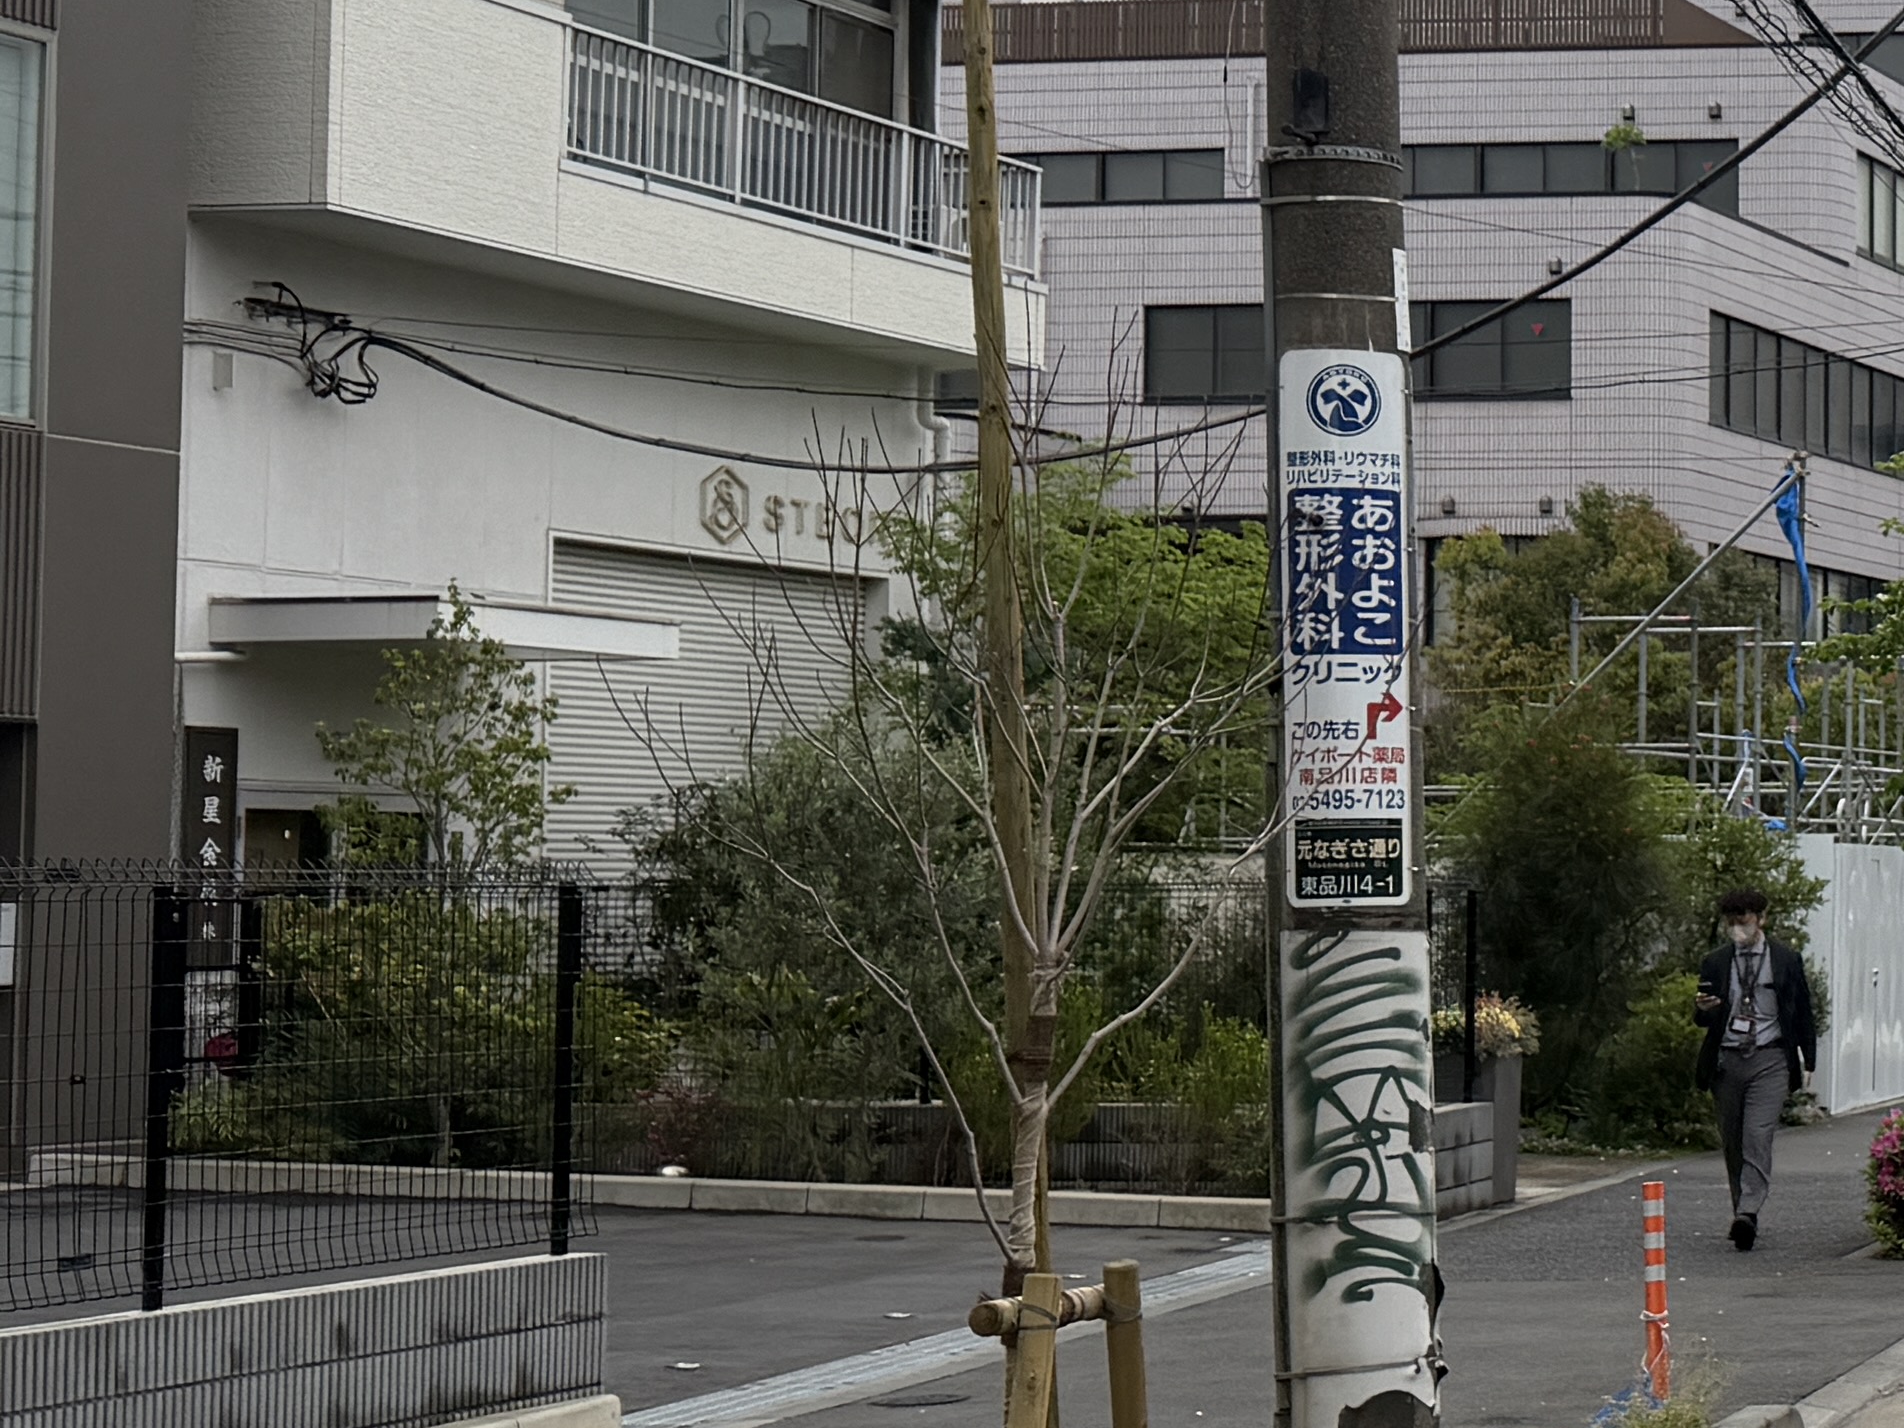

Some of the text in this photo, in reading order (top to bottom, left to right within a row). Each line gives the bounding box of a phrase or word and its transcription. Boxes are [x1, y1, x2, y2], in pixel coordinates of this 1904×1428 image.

[1286, 451, 1400, 469] 整形外科・リウマチ科
[1286, 468, 1401, 486] リハビリテーション科
[1293, 493, 1345, 651] 整形外科
[1351, 495, 1396, 645] あおよこ
[1291, 660, 1402, 686] クリニック
[1292, 720, 1360, 740] この先右
[1291, 746, 1405, 764] ケイポート薬局
[1297, 838, 1400, 860] 元なぎさ通り
[1301, 874, 1394, 896] 東品川4-1
